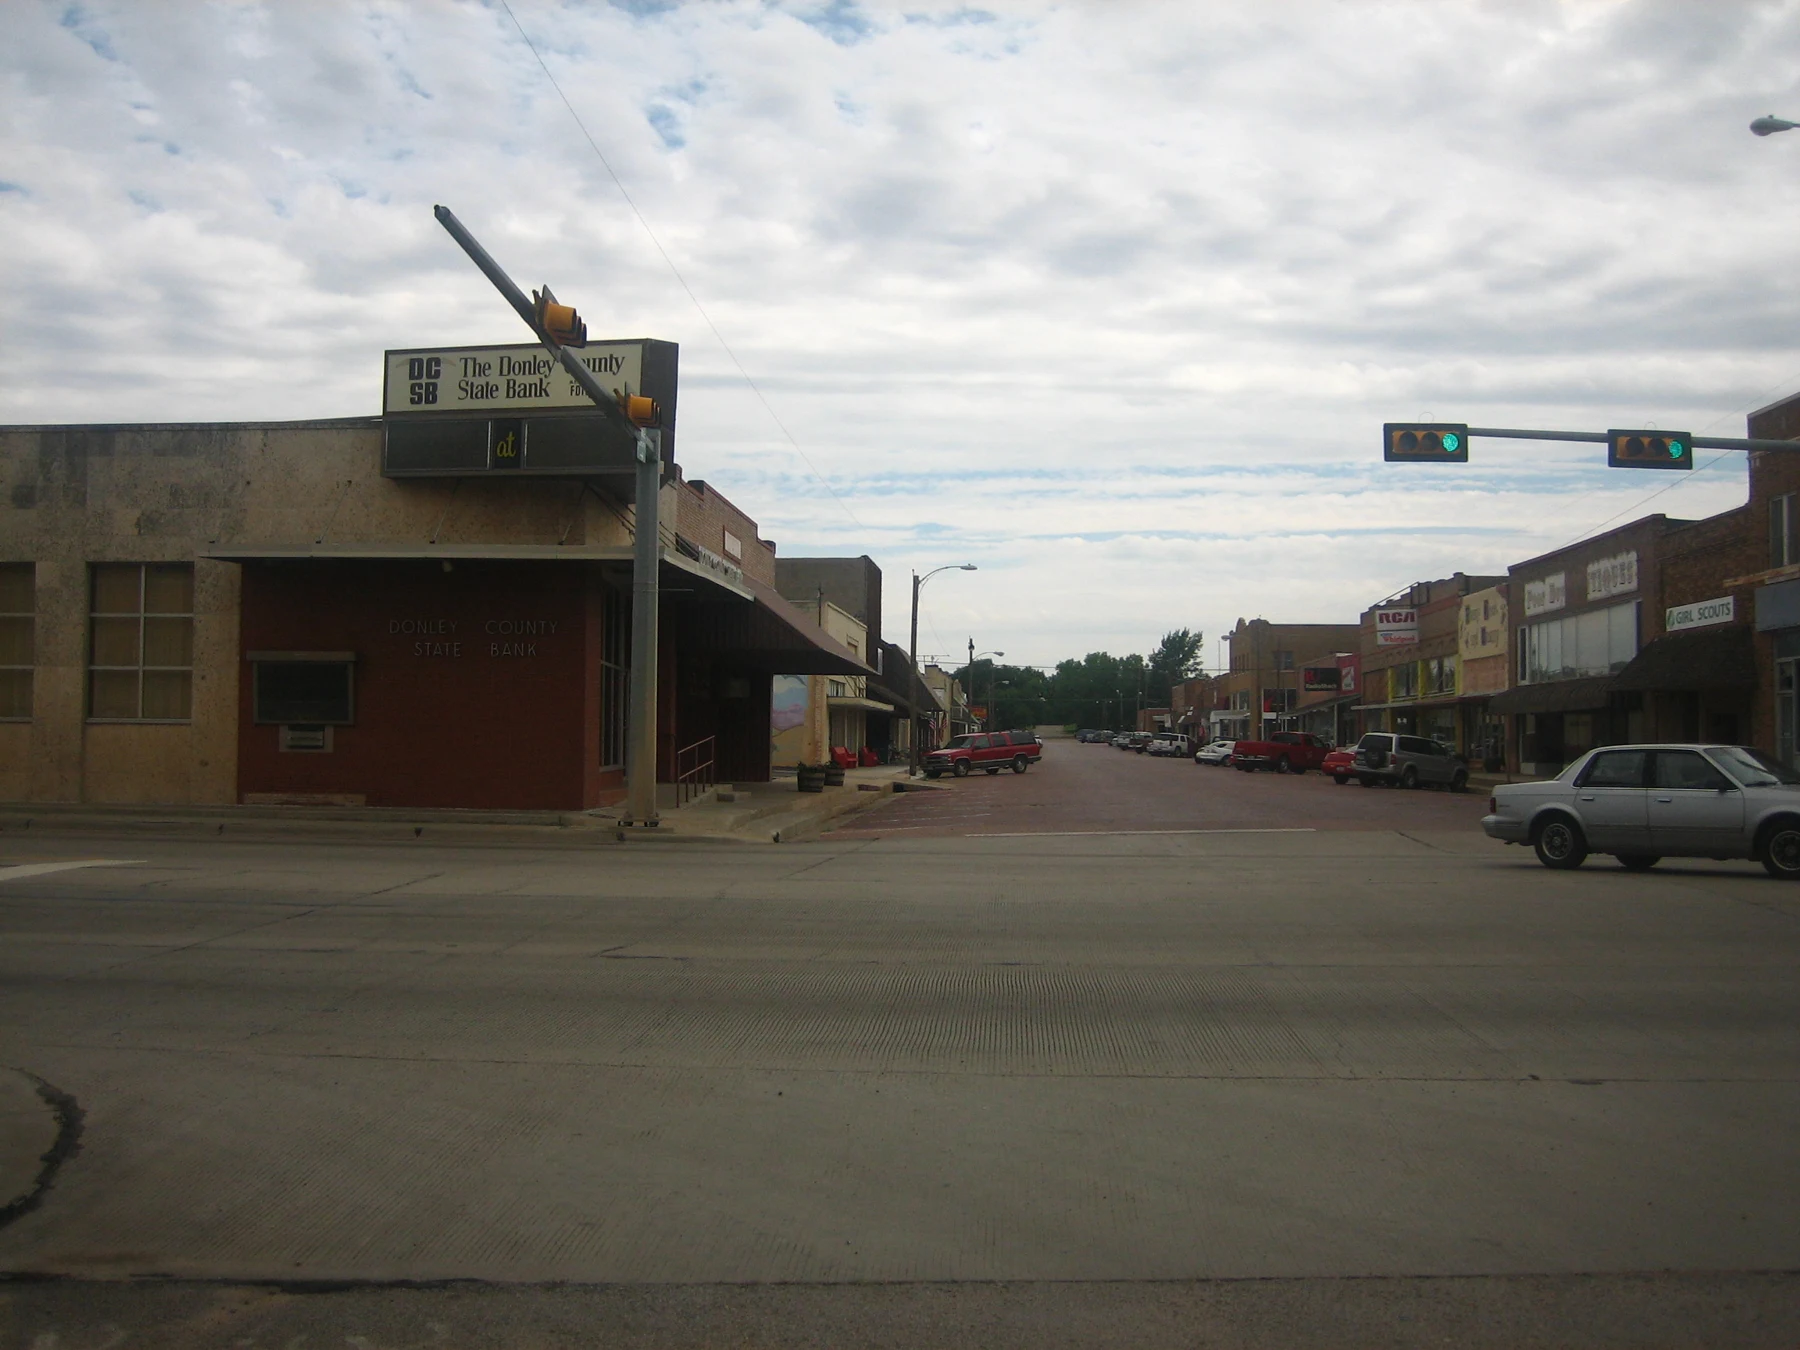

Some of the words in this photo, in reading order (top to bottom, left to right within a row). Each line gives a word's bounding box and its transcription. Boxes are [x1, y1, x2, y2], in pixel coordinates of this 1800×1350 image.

[408, 357, 441, 380] DC
[459, 356, 492, 378] The
[499, 354, 556, 379] Donley
[565, 352, 625, 376] unty
[409, 382, 438, 405] SB
[458, 379, 499, 401] State
[505, 378, 551, 399] Bank
[496, 431, 516, 458] at
[1378, 612, 1415, 624] RCA
[1675, 610, 1694, 624] GIRL
[1698, 602, 1731, 620] SCOUTS
[389, 619, 458, 634] DONLEY
[485, 620, 558, 635] COUNTY
[414, 642, 462, 657] STATE
[490, 642, 537, 657] BANK
[1383, 635, 1416, 643] Whirlpool
